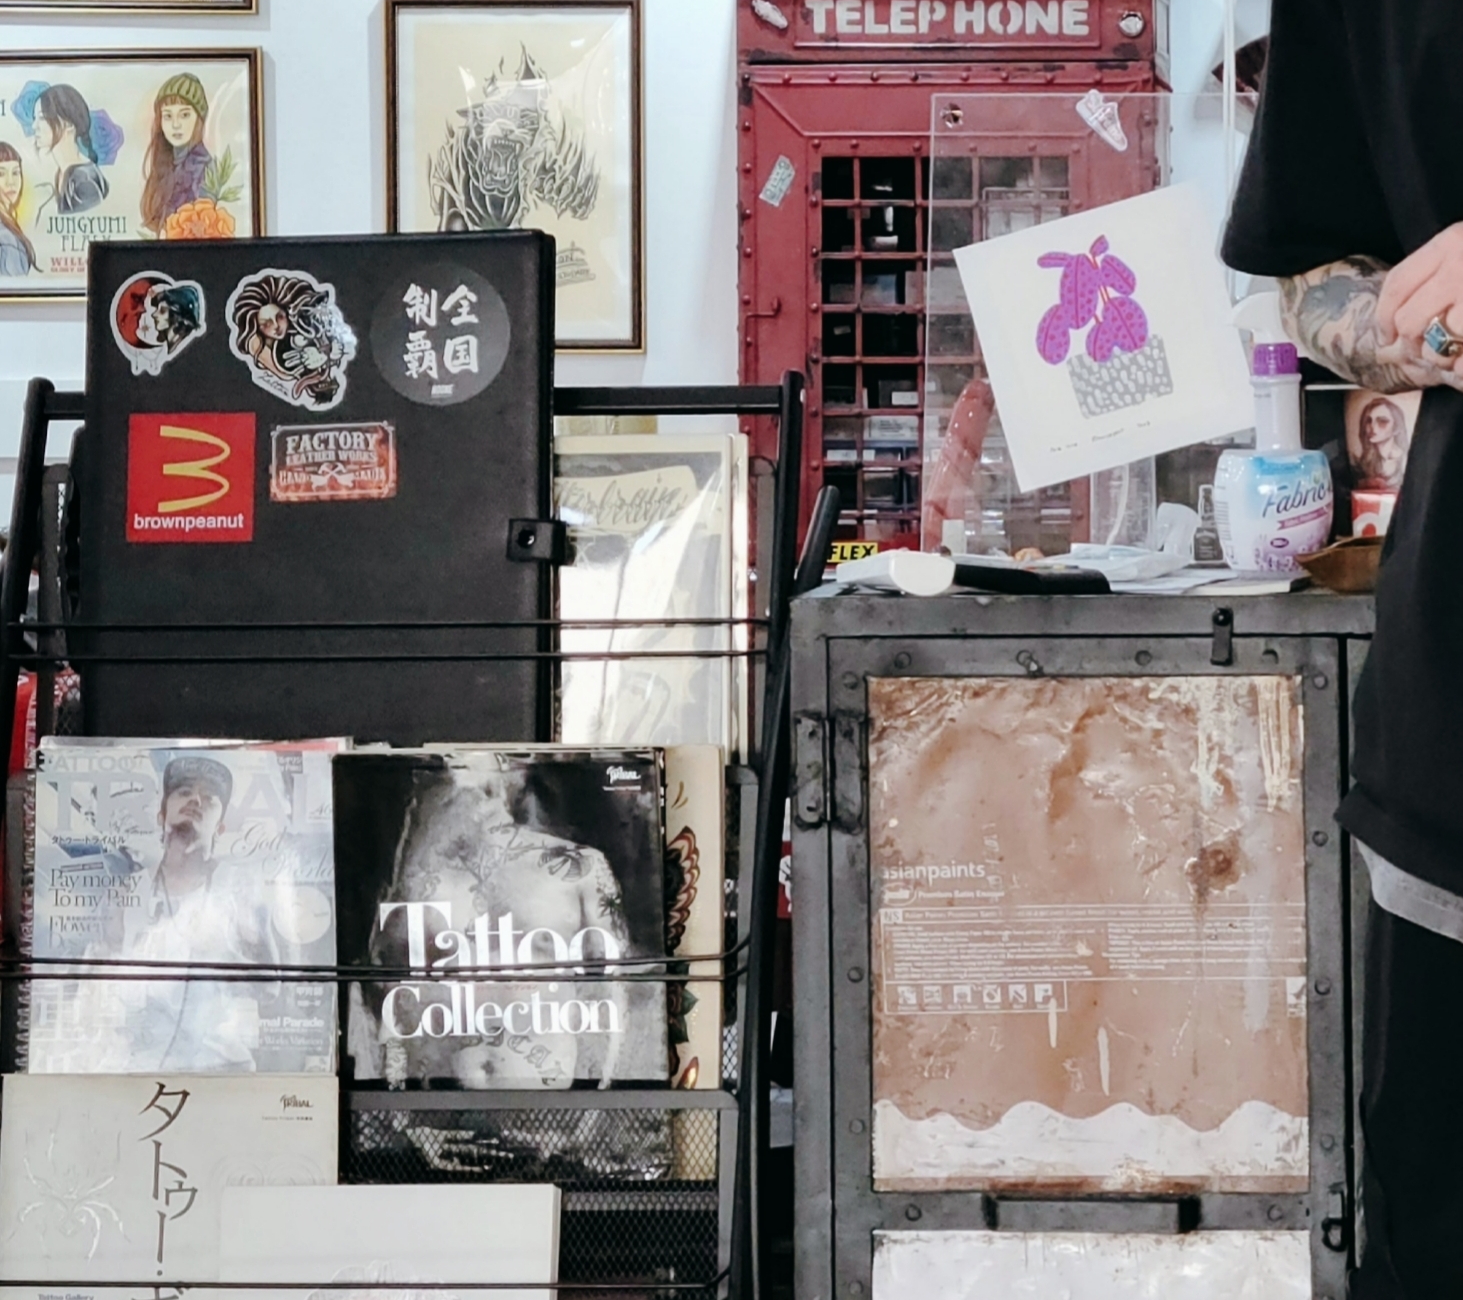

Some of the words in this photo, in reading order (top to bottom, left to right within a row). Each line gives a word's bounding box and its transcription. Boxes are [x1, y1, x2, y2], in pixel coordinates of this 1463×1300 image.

[46, 216, 127, 234] JUNGYUMI
[285, 430, 378, 455] FACTORY
[285, 450, 336, 465] LEATHER
[338, 450, 378, 463] WORKS
[133, 512, 244, 533] brownpeanut
[829, 544, 876, 561] FLEX
[50, 868, 80, 894] Pay
[82, 874, 142, 894] money
[48, 887, 72, 908] To
[74, 893, 103, 913] my
[106, 888, 142, 908] Pain
[883, 910, 900, 922] NS
[378, 901, 622, 976] Tattoo
[381, 980, 625, 1039] Collection
